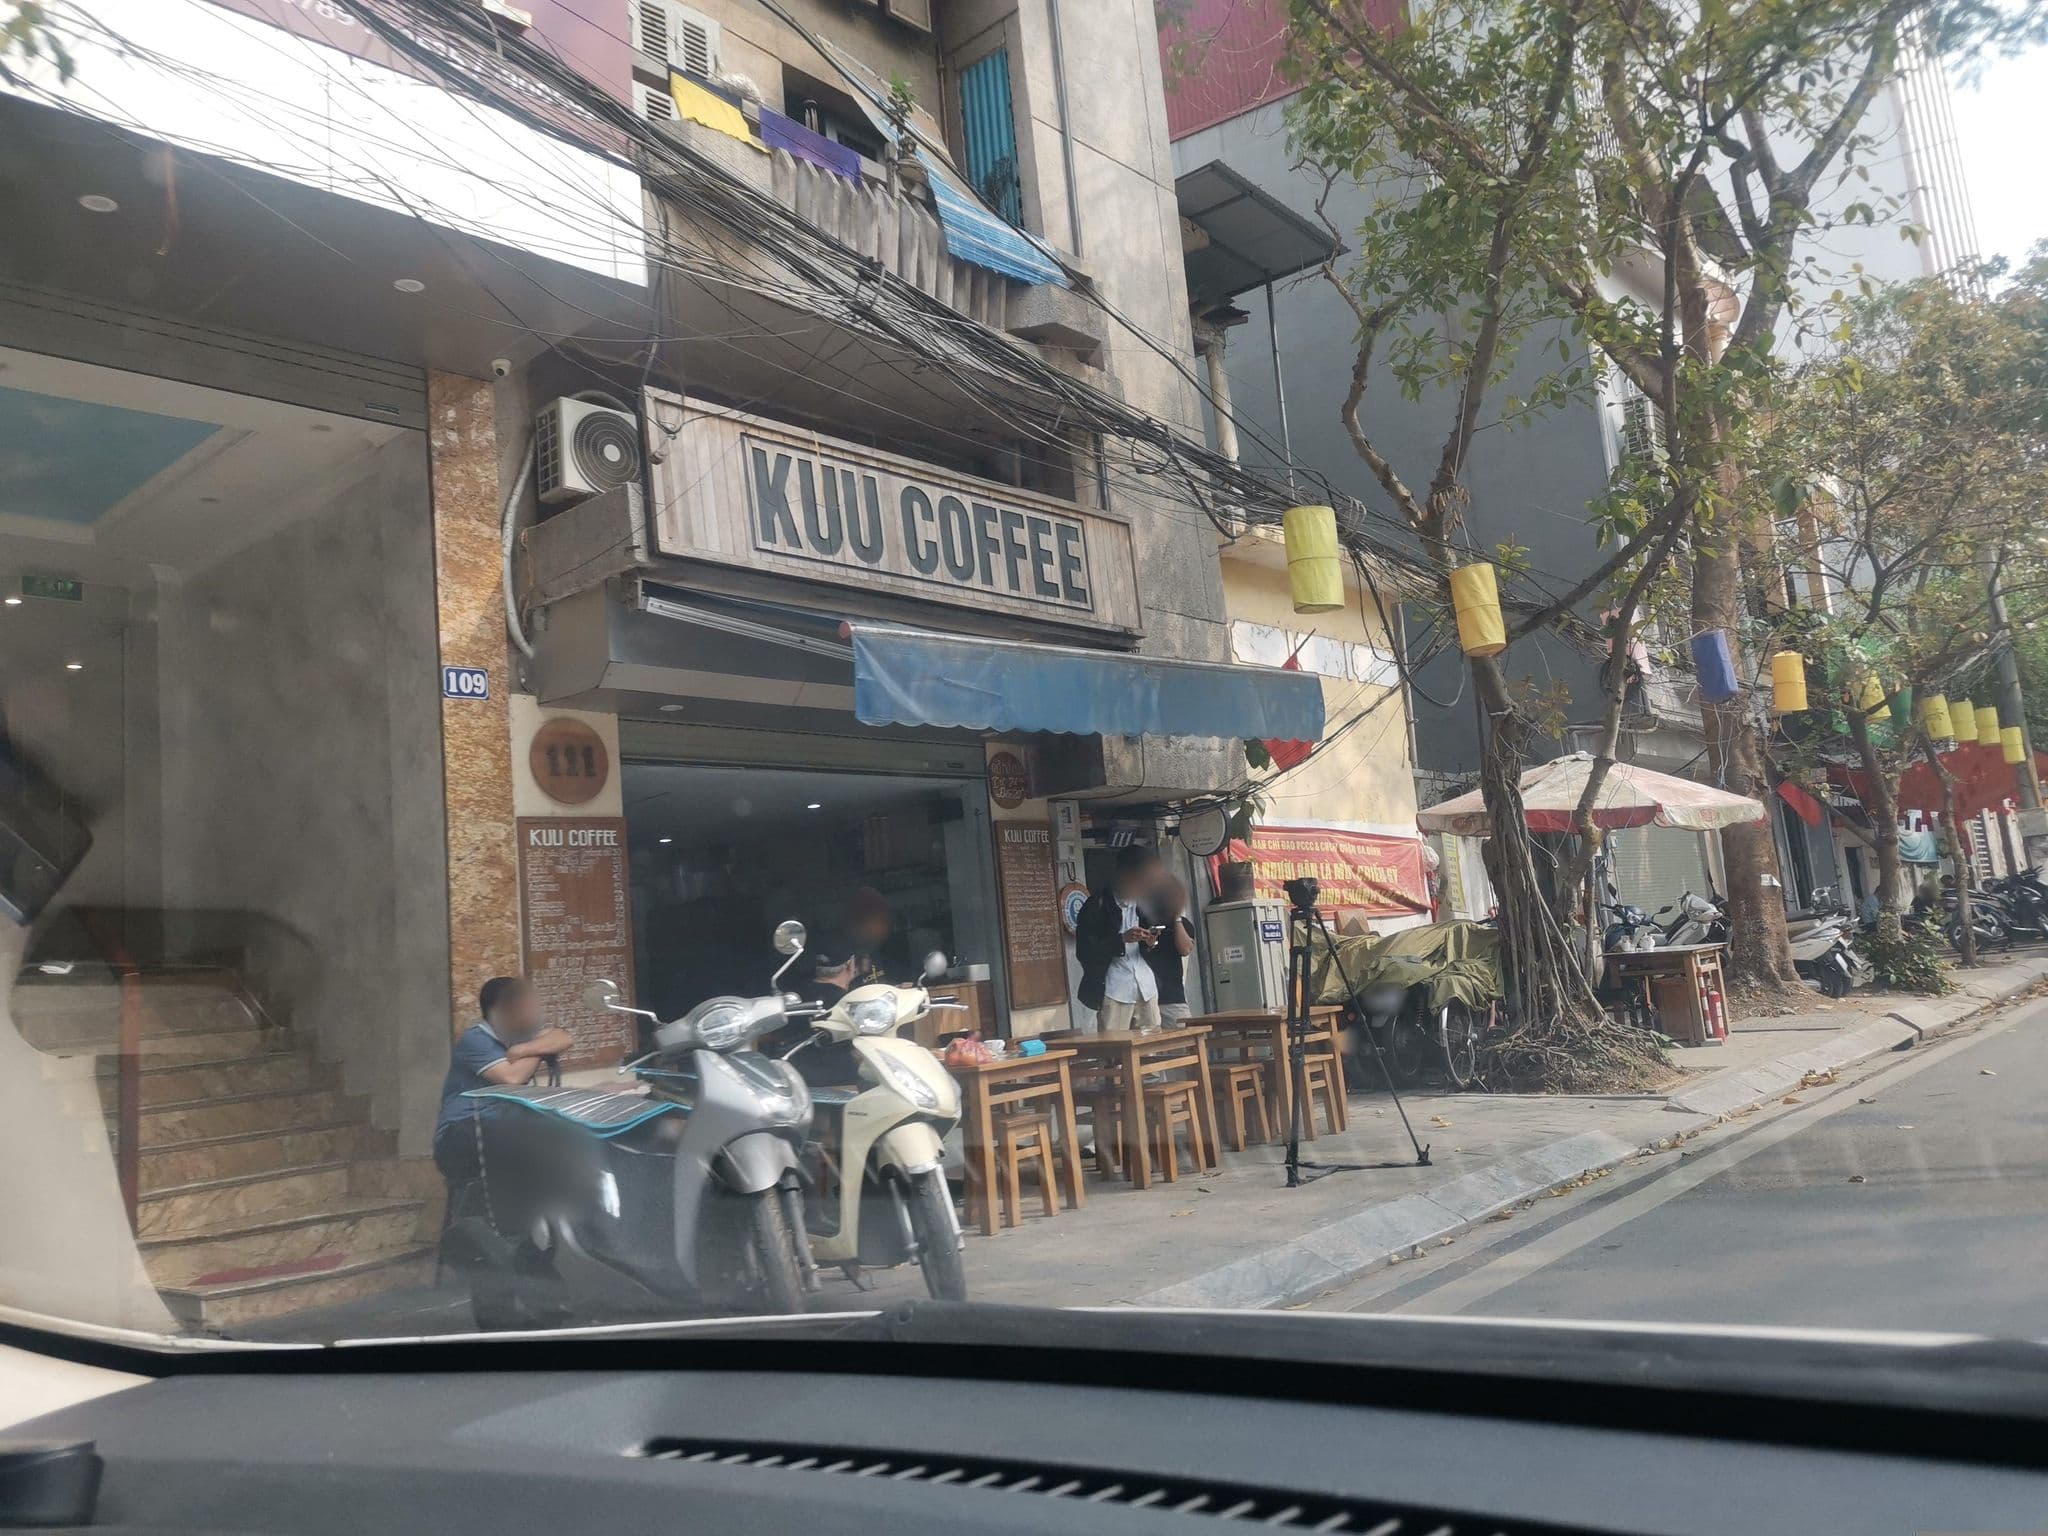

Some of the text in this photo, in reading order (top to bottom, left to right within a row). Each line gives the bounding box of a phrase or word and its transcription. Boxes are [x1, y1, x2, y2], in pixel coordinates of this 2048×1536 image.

[752, 447, 1087, 602] KUU COFFEE
[448, 672, 487, 694] 109
[529, 829, 619, 847] KUU COFFEE
[1004, 829, 1050, 843] KUU COFFEE
[1320, 859, 1332, 880] LÀ
